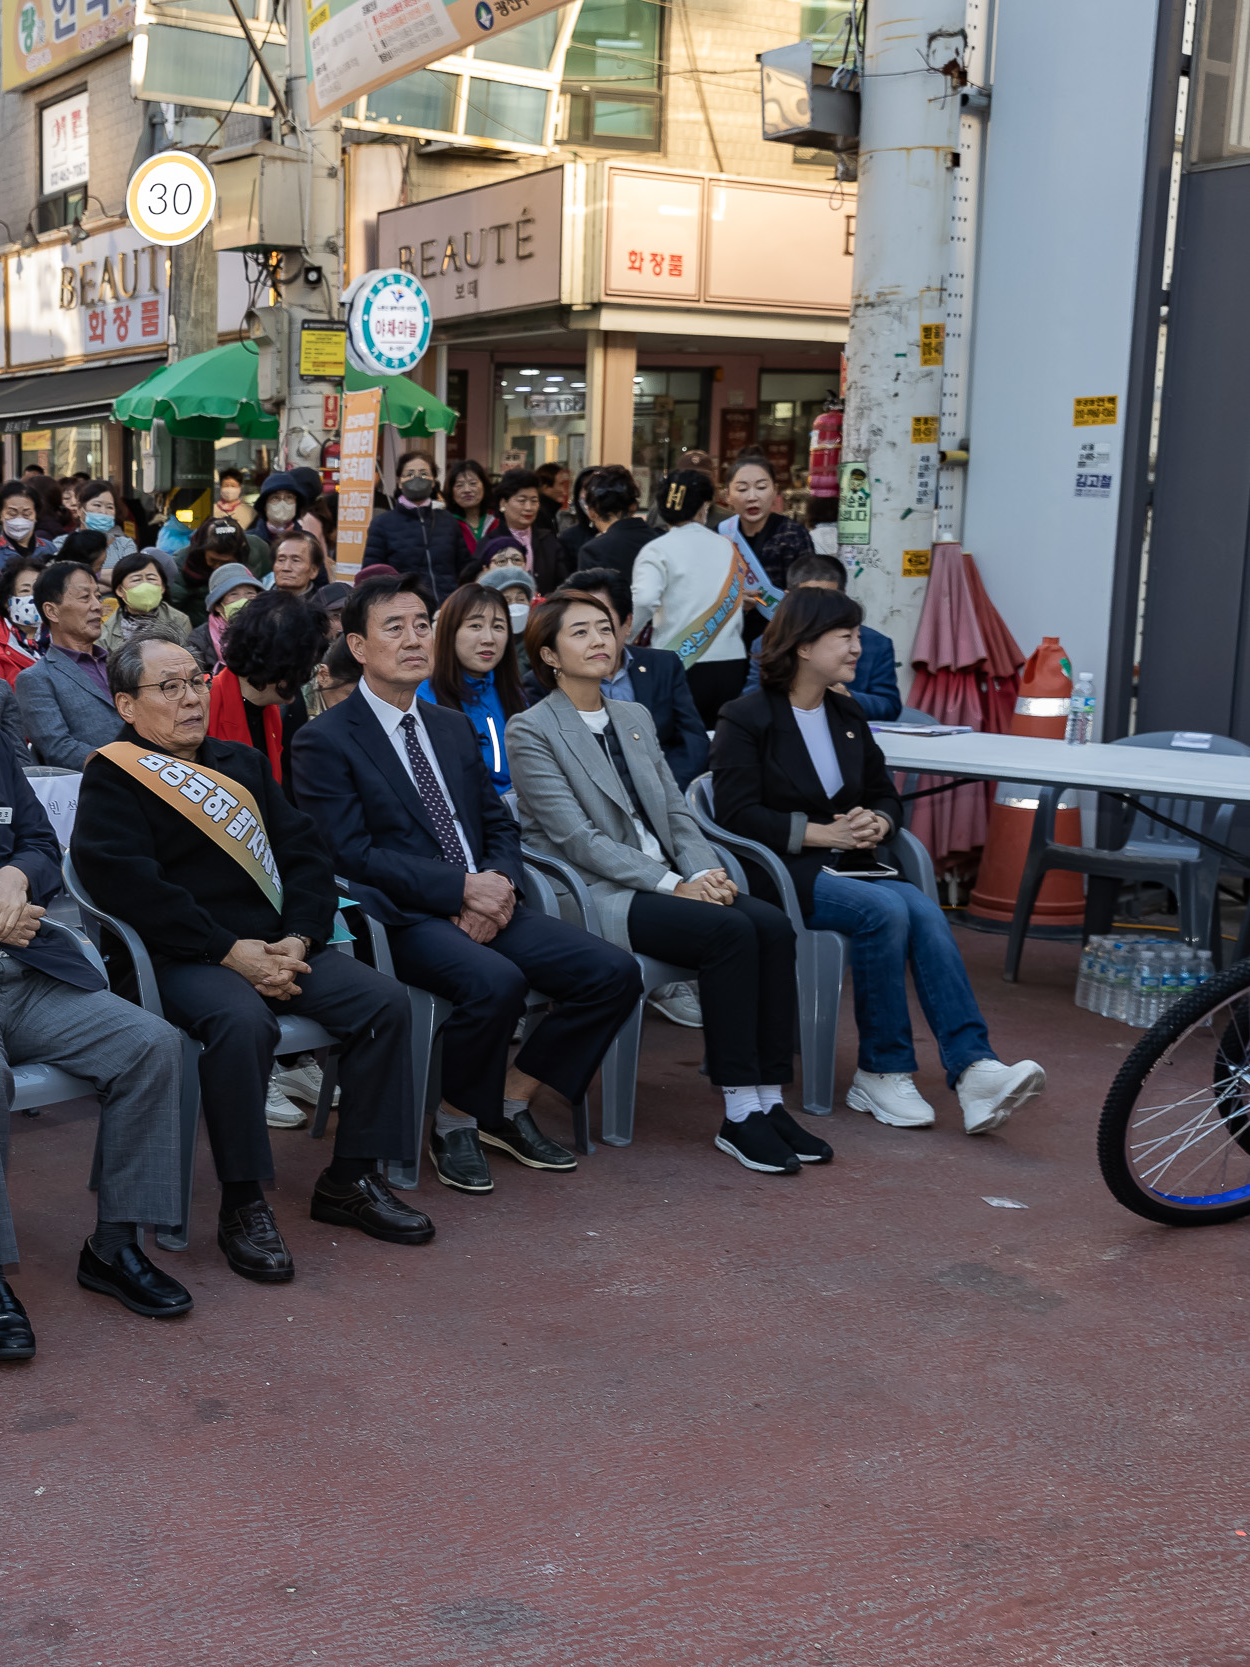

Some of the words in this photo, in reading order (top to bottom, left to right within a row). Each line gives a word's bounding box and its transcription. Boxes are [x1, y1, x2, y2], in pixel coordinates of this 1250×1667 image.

[148, 183, 192, 215] 30
[398, 207, 534, 281] BEAUTÉ
[627, 249, 683, 278] 화장품
[88, 299, 160, 344] 화장품
